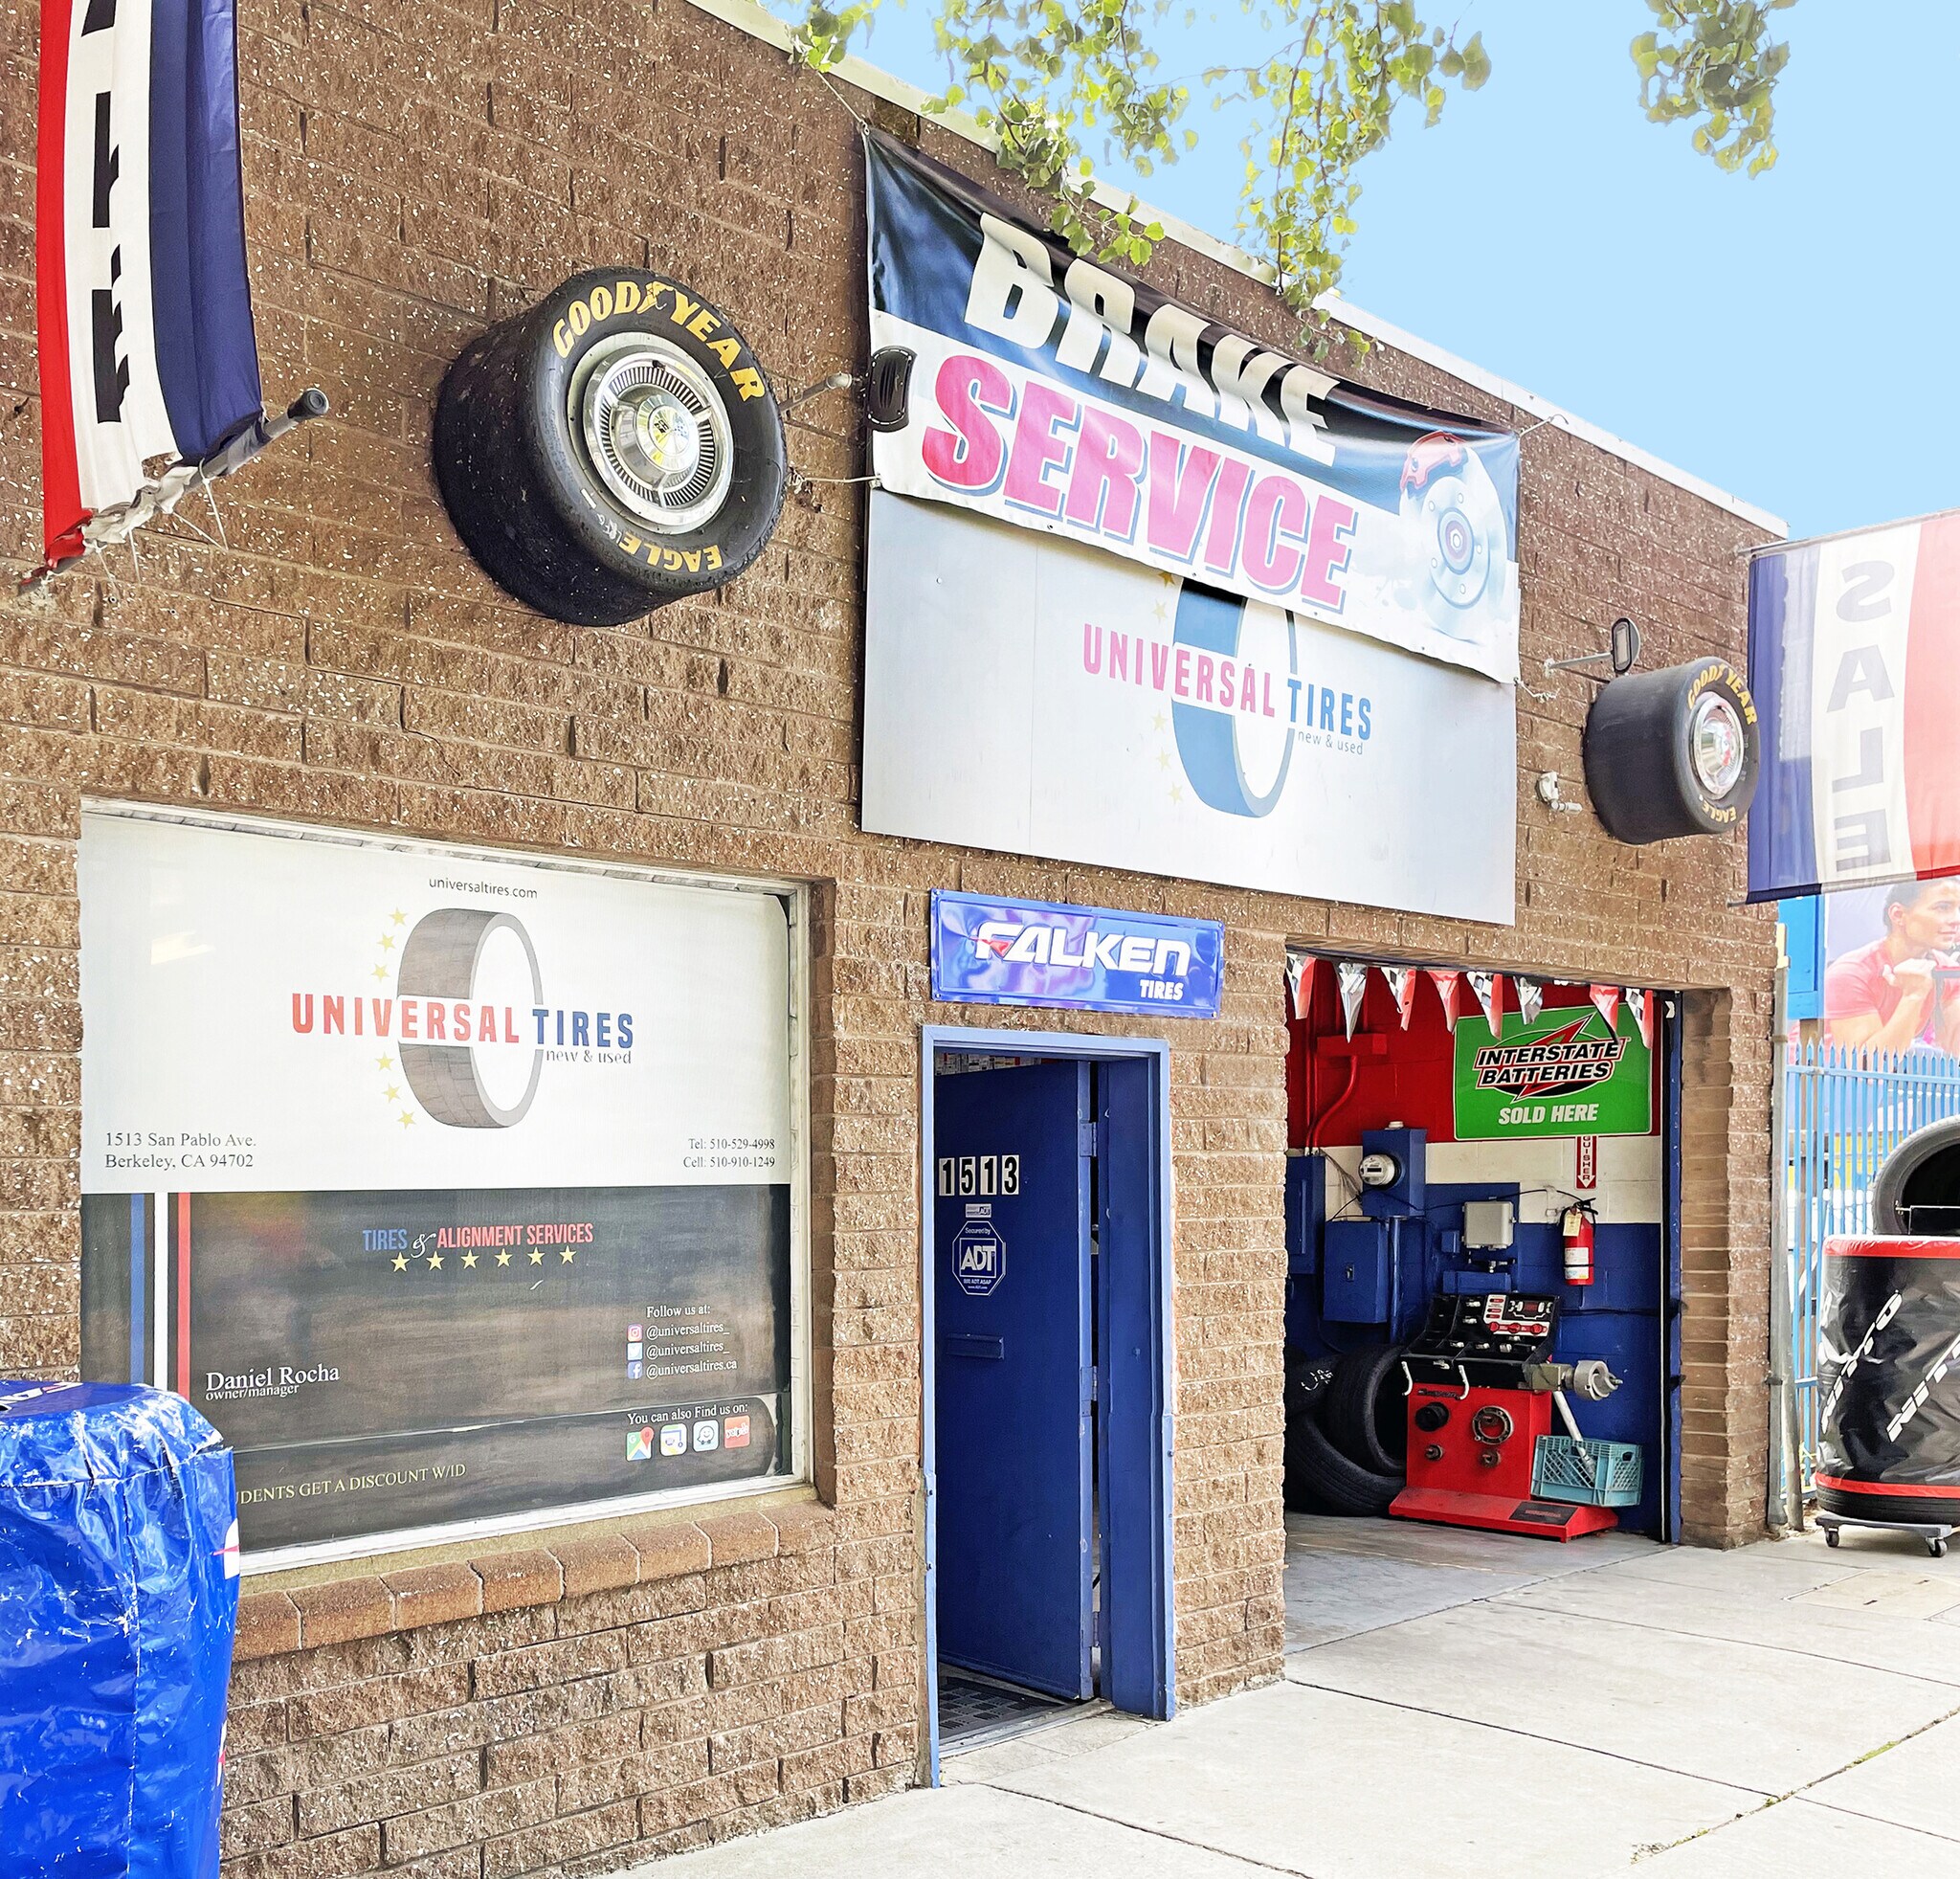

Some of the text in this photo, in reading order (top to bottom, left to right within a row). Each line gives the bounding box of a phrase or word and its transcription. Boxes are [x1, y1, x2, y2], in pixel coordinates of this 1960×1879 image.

[964, 212, 1341, 467] BRAKE
[922, 354, 1359, 614] SERVICE
[618, 531, 724, 573] EAGLE
[1083, 623, 1371, 740] UNIVERSAL TIRES
[1298, 729, 1364, 756] new & used
[1702, 800, 1737, 824] EAGLE
[429, 878, 538, 899] universaltires.com
[974, 921, 1192, 977] FALKEN
[1140, 979, 1184, 1001] TIRES
[292, 993, 634, 1049] UNIVERSAL TIRES
[546, 1049, 632, 1064] new & used
[1478, 1040, 1621, 1066] INTERSTATE
[1481, 1062, 1611, 1085] BATTERIES
[1498, 1103, 1599, 1126] SOLD HERE
[106, 1132, 256, 1147] 1513 San Pablo Ave.
[688, 1138, 775, 1150] Tel: 510-529-4998
[105, 1153, 254, 1171] Berkeley, CA 94702
[683, 1156, 775, 1168] Cell: 510-910-1249
[942, 1156, 1017, 1195] 1513
[363, 1222, 593, 1259] TIRES & ALIGNMENT SERVICES
[961, 1245, 995, 1272] ADT
[646, 1304, 711, 1318] Follow us at:
[646, 1322, 730, 1340] @universaltires_
[646, 1341, 730, 1360] @universaltires_
[206, 1363, 340, 1391] Daniel Rocha
[646, 1359, 737, 1379] @universaltires.ca
[205, 1384, 300, 1401] owner/manager
[628, 1403, 748, 1425] You can also Find us on:
[299, 1480, 331, 1497] GET
[335, 1478, 345, 1493] A
[349, 1467, 428, 1491] DISCOUNT
[433, 1464, 466, 1480] W/ID
